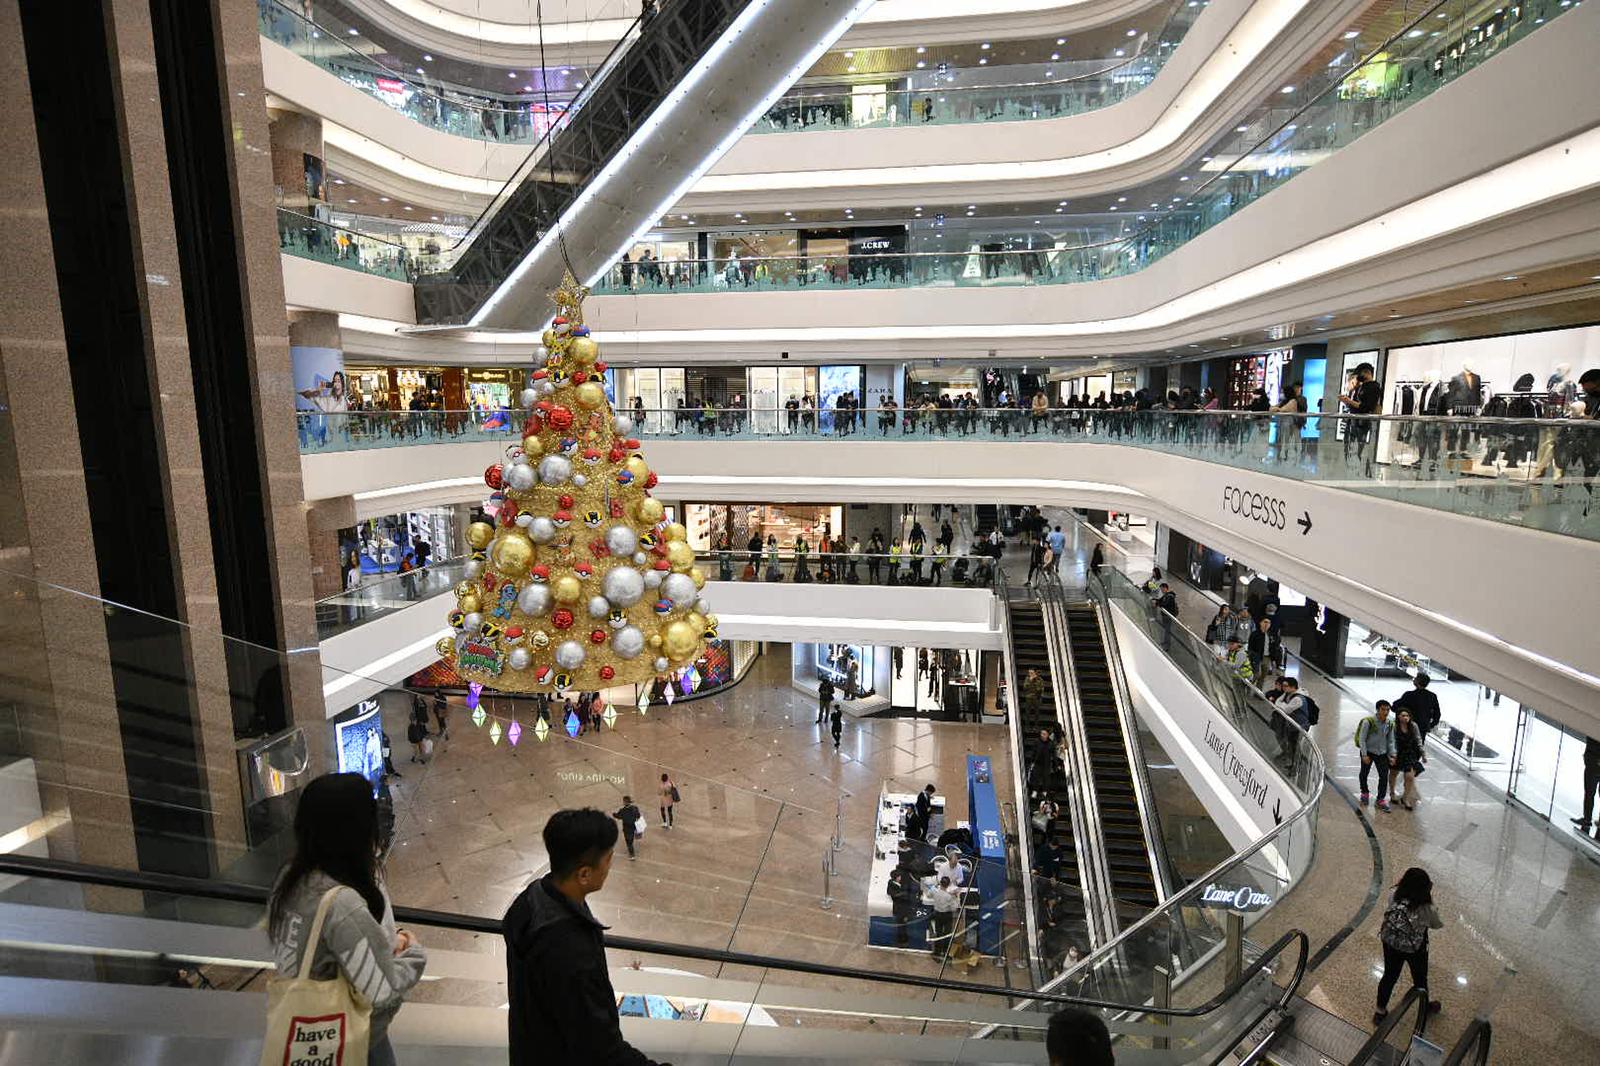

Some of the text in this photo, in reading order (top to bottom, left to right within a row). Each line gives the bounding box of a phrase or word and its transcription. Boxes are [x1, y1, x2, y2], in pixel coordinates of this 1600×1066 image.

[1203, 720, 1268, 808] Lane Crawford
[1200, 883, 1234, 902] Lane
[295, 1026, 337, 1043] have
[308, 1044, 318, 1056] a
[291, 1053, 334, 1066] good
